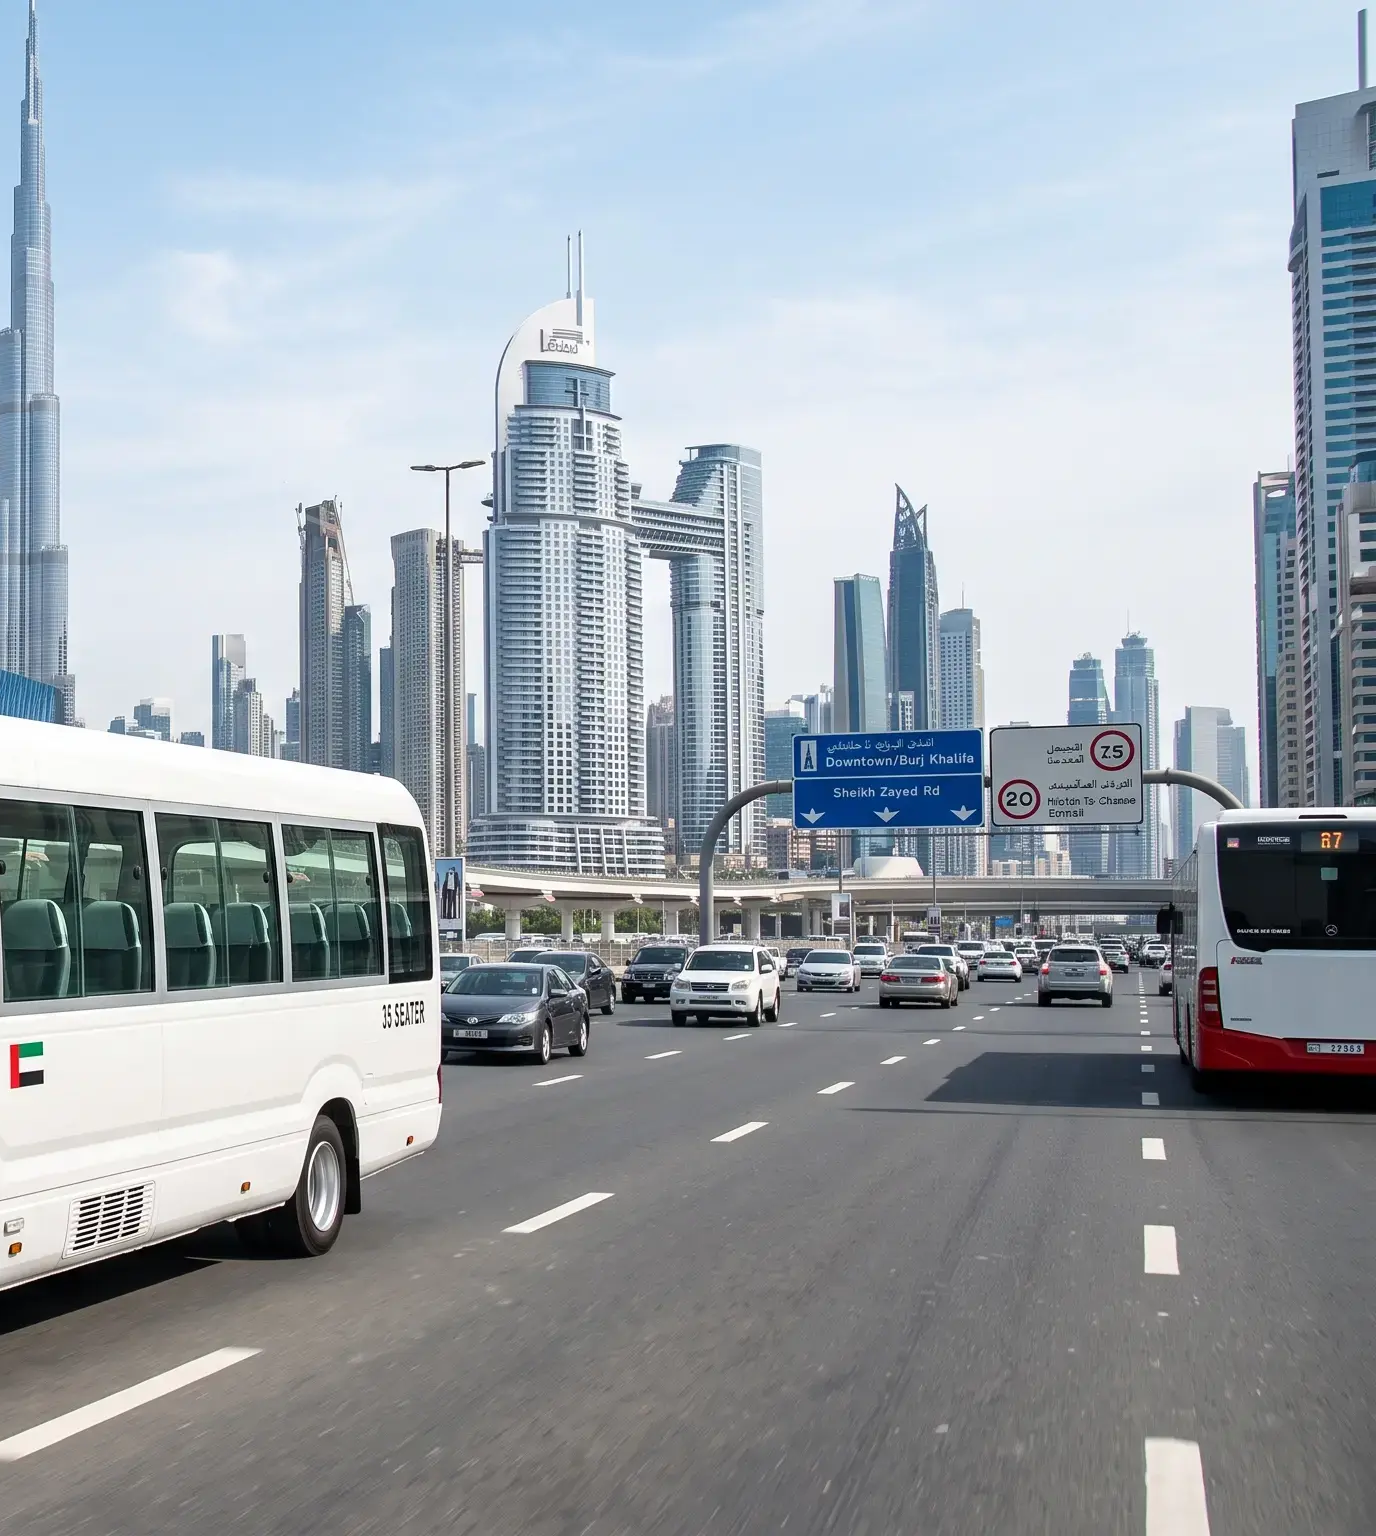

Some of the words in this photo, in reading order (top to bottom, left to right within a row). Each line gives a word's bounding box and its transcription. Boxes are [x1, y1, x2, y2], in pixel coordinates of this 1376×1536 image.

[826, 754, 924, 768] Downtown/Burj
[929, 753, 974, 765] Khalifa
[833, 787, 875, 798] Sheikh
[880, 786, 918, 799] Zayed
[924, 785, 940, 796] Rd
[1006, 791, 1033, 807] 20
[382, 1003, 392, 1029] 35
[394, 1000, 425, 1027] SEATER
